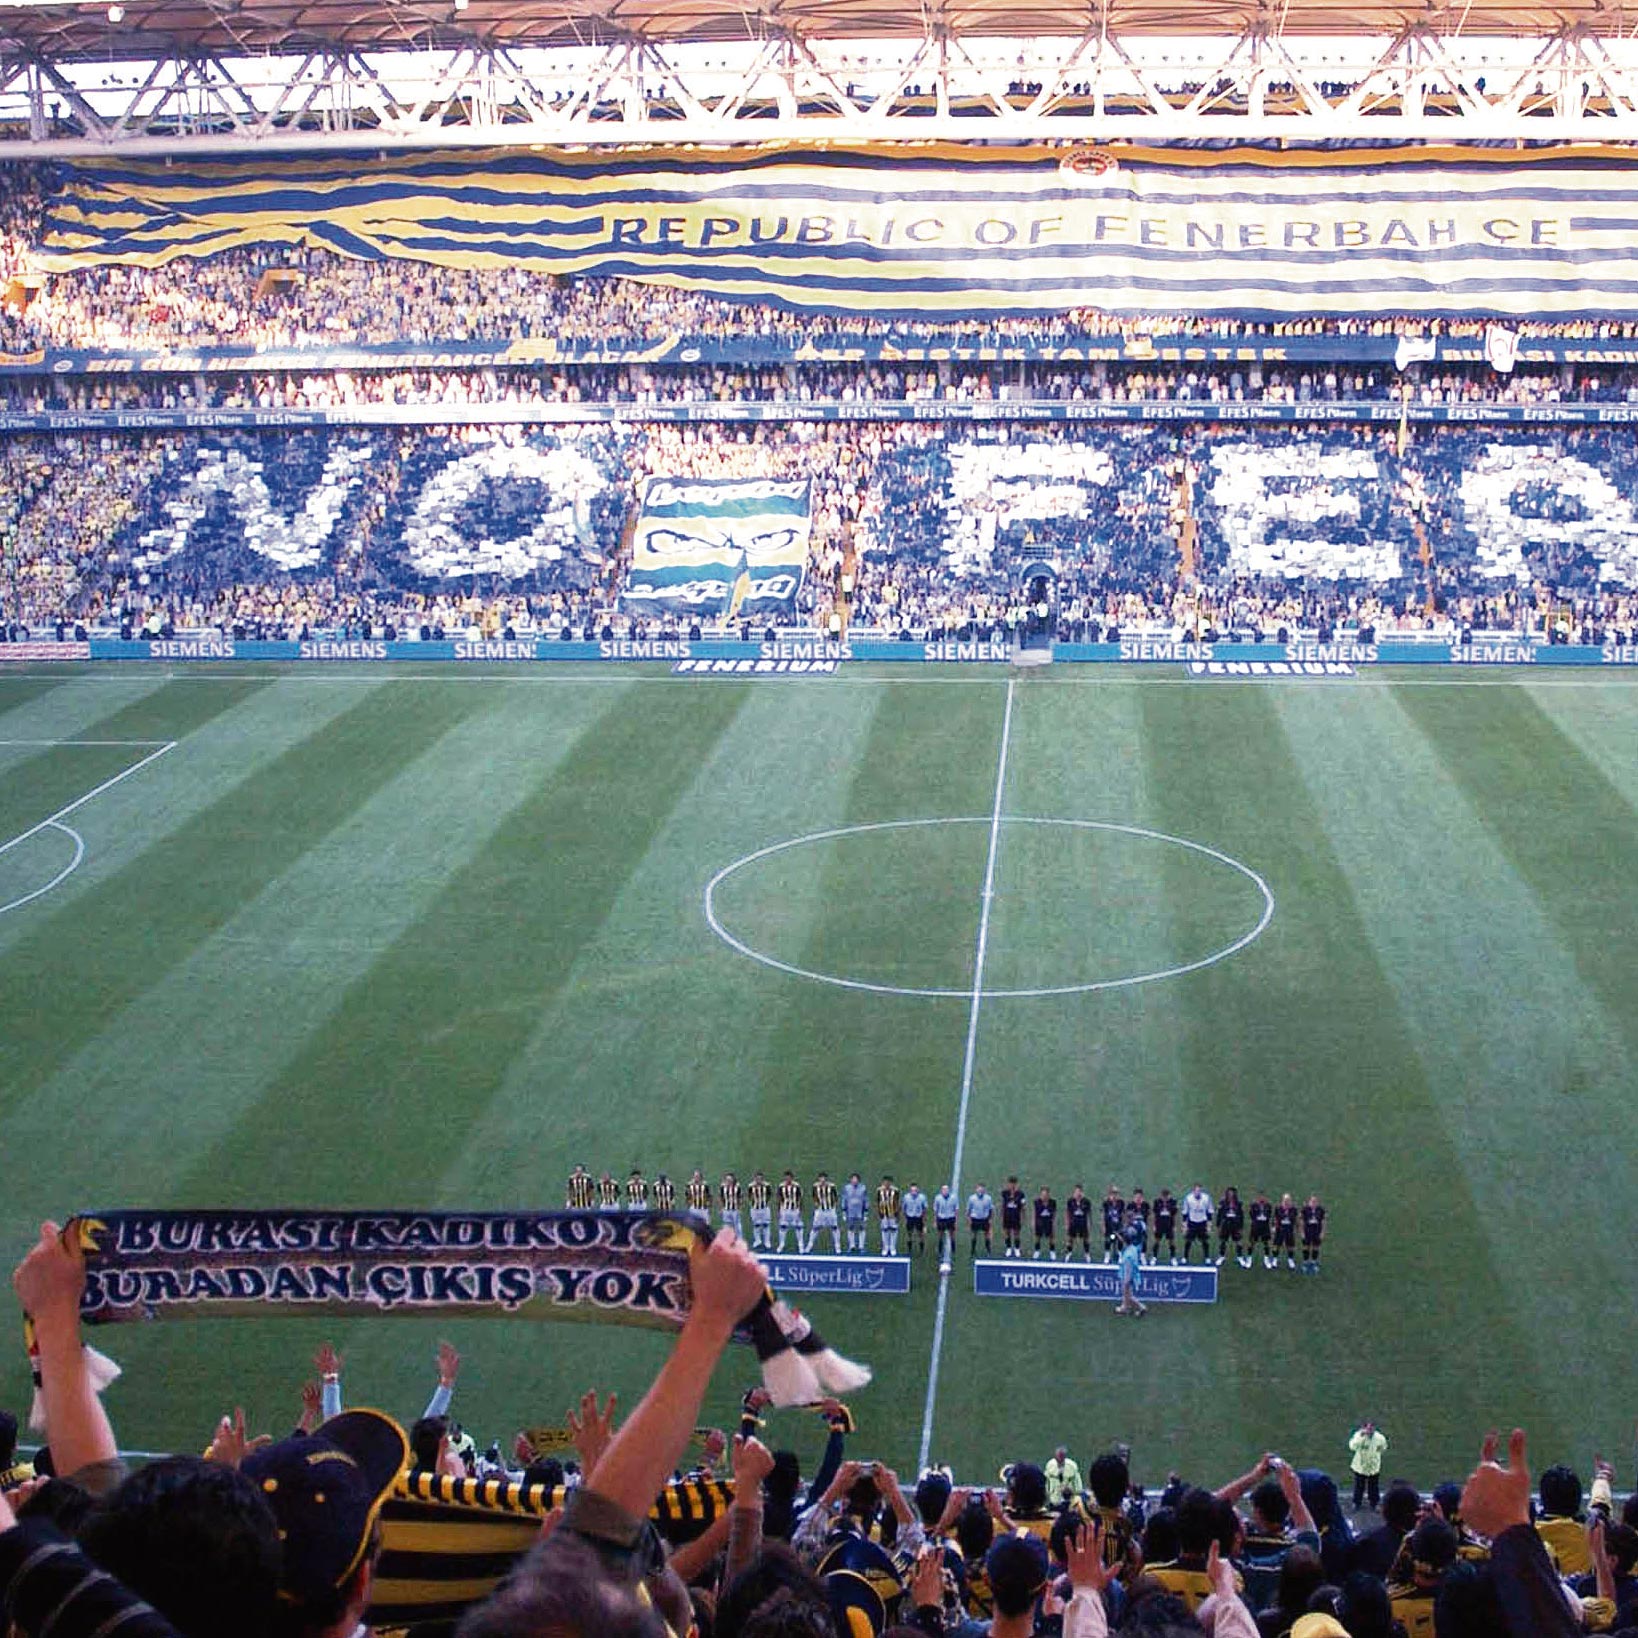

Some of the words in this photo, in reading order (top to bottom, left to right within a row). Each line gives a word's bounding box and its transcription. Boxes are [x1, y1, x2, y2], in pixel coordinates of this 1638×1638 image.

[611, 215, 945, 246] REPUBLIC
[974, 216, 1063, 245] OF
[1039, 349, 1119, 360] TAM
[150, 640, 236, 657] SIEMENS
[300, 641, 387, 658] SIEMENS
[600, 641, 691, 658] SIEMENS
[760, 642, 854, 660] SIEMENS
[1120, 643, 1214, 660] SIEMENS
[1286, 643, 1379, 662] SIEMENS
[677, 659, 835, 672] FENERIUM
[116, 1218, 344, 1253] BURASI
[79, 1262, 352, 1312] BURADAN
[366, 1262, 536, 1311] ÇIKIŞ
[546, 1264, 684, 1312] YOK
[1001, 1272, 1090, 1291] TURKCELL
